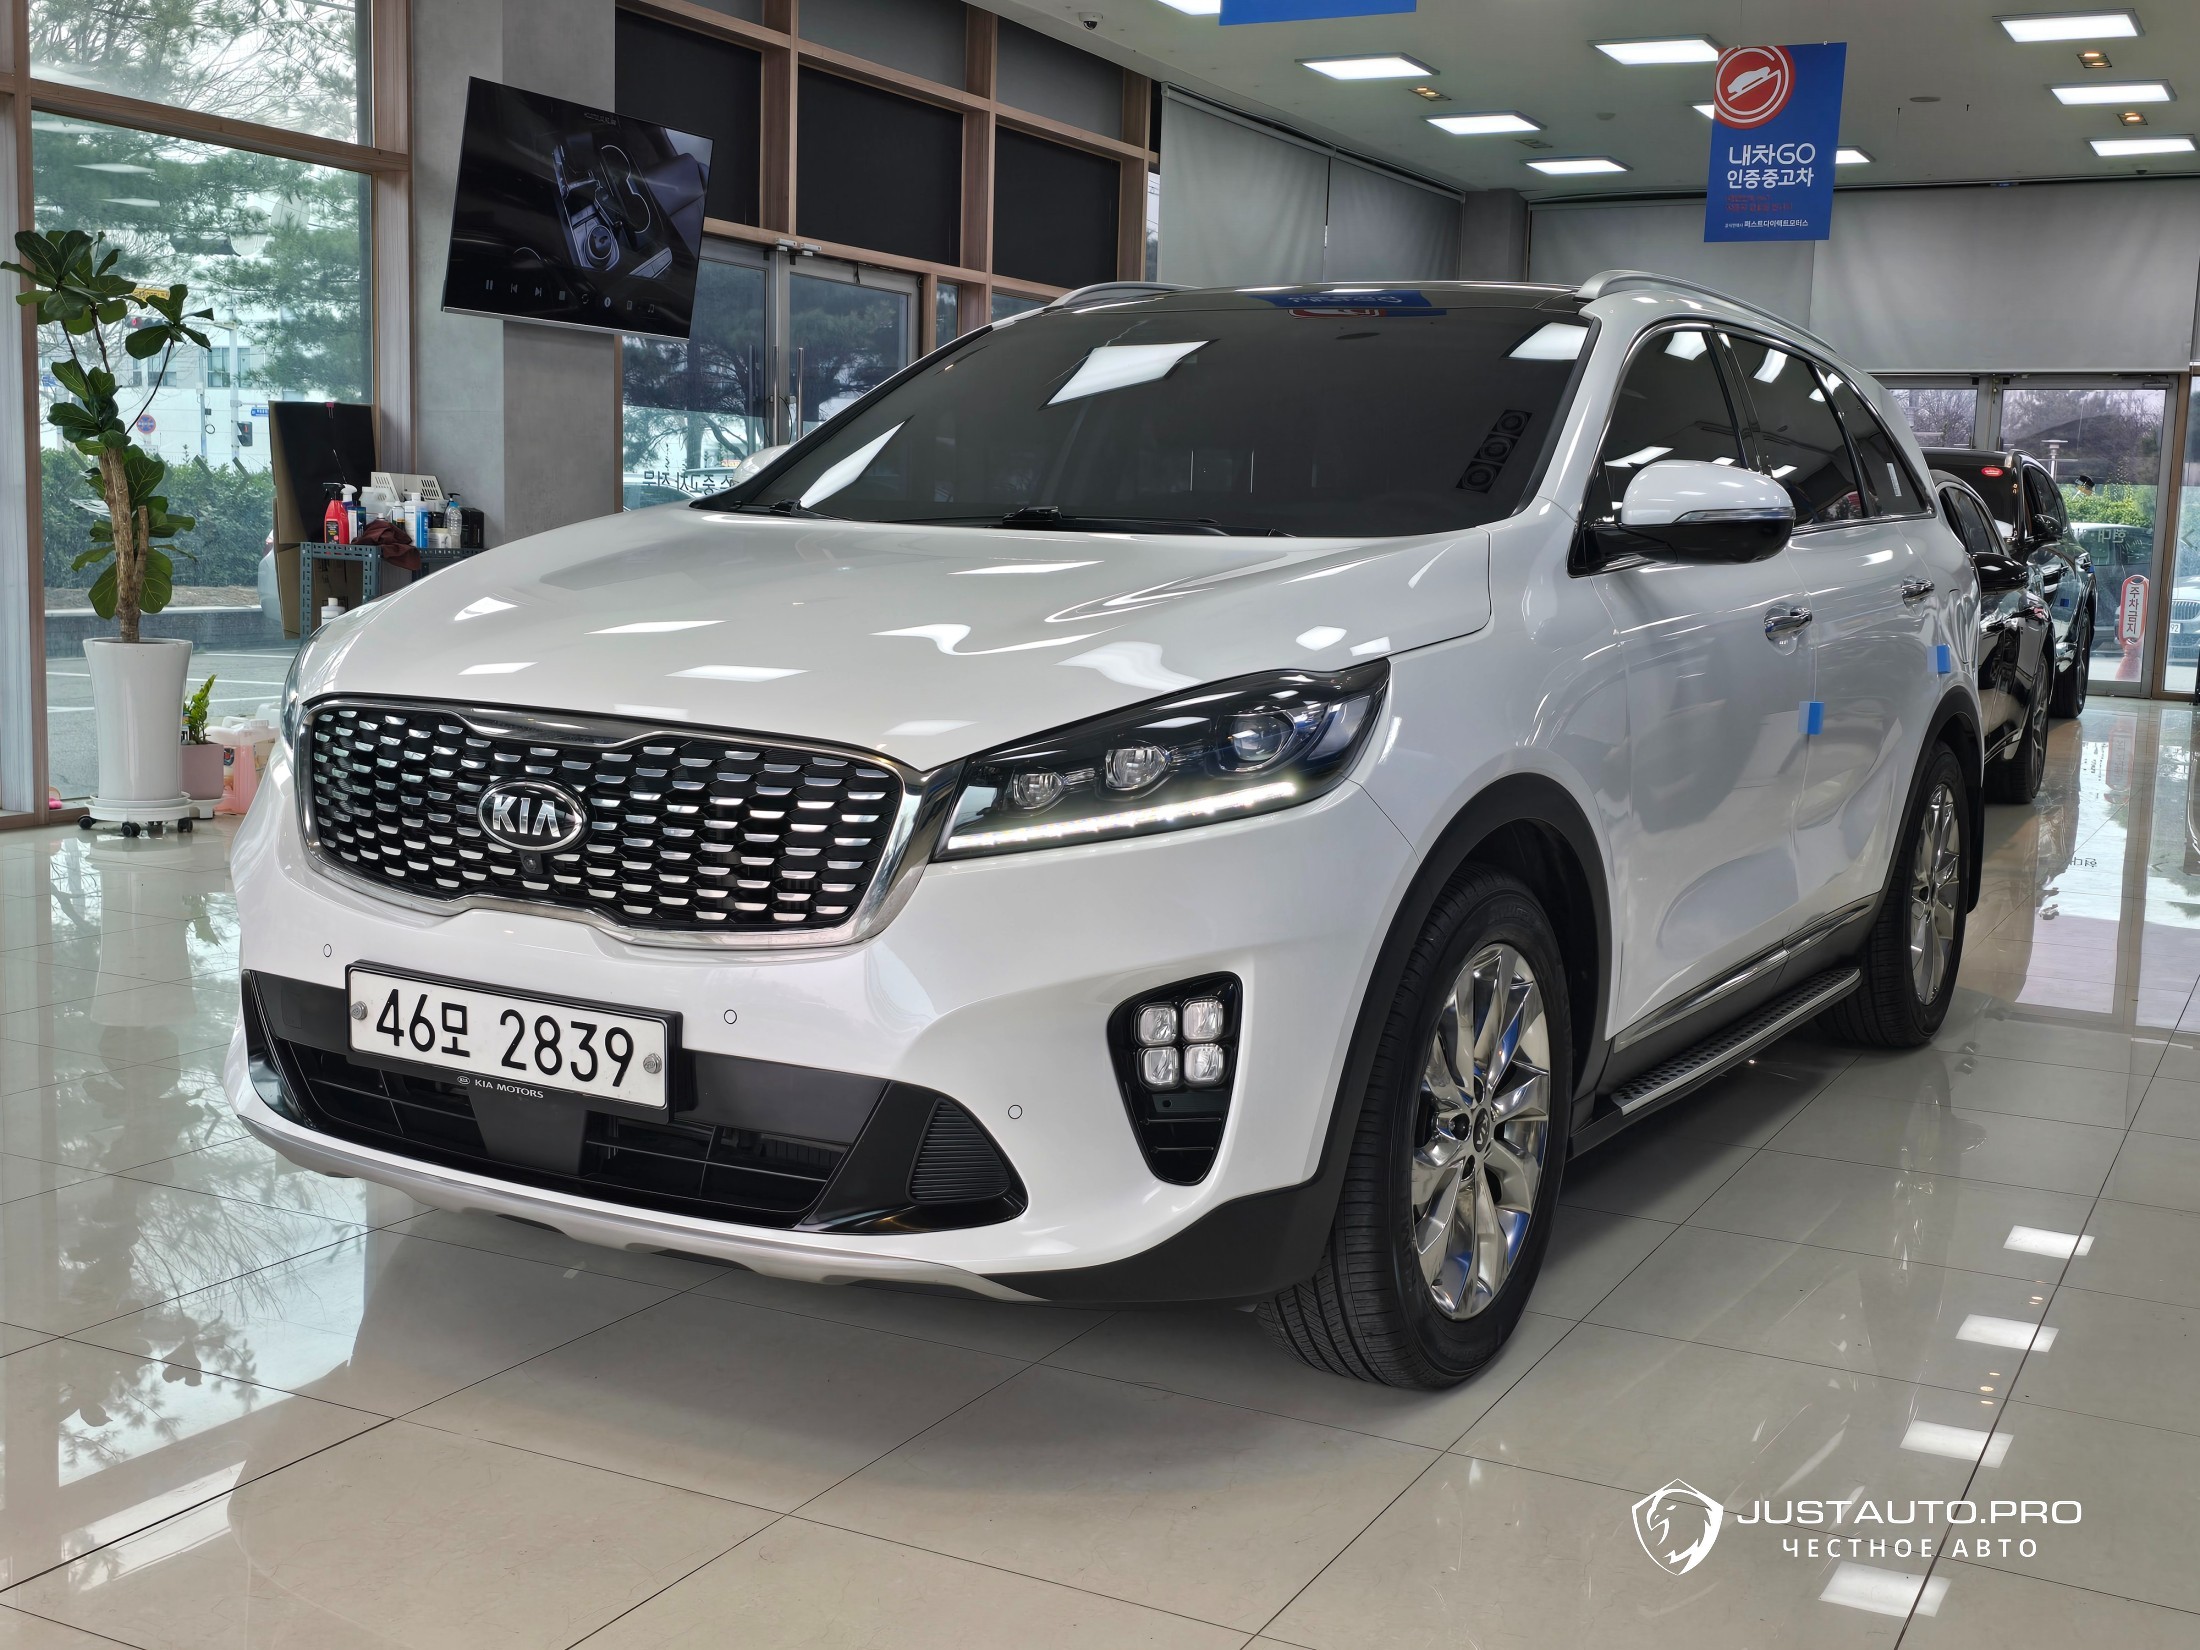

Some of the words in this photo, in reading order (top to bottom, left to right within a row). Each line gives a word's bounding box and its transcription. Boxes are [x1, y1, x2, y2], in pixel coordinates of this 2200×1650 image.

[1729, 142, 1816, 166] 내차GO
[1727, 167, 1814, 189] 인증중고차
[2126, 586, 2140, 634] 주차금지
[2170, 623, 2179, 632] 92
[493, 795, 561, 837] KIA
[376, 988, 470, 1057] 46모
[500, 1009, 634, 1087] 2839
[475, 1079, 493, 1089] KIA
[496, 1083, 544, 1099] MOTORS
